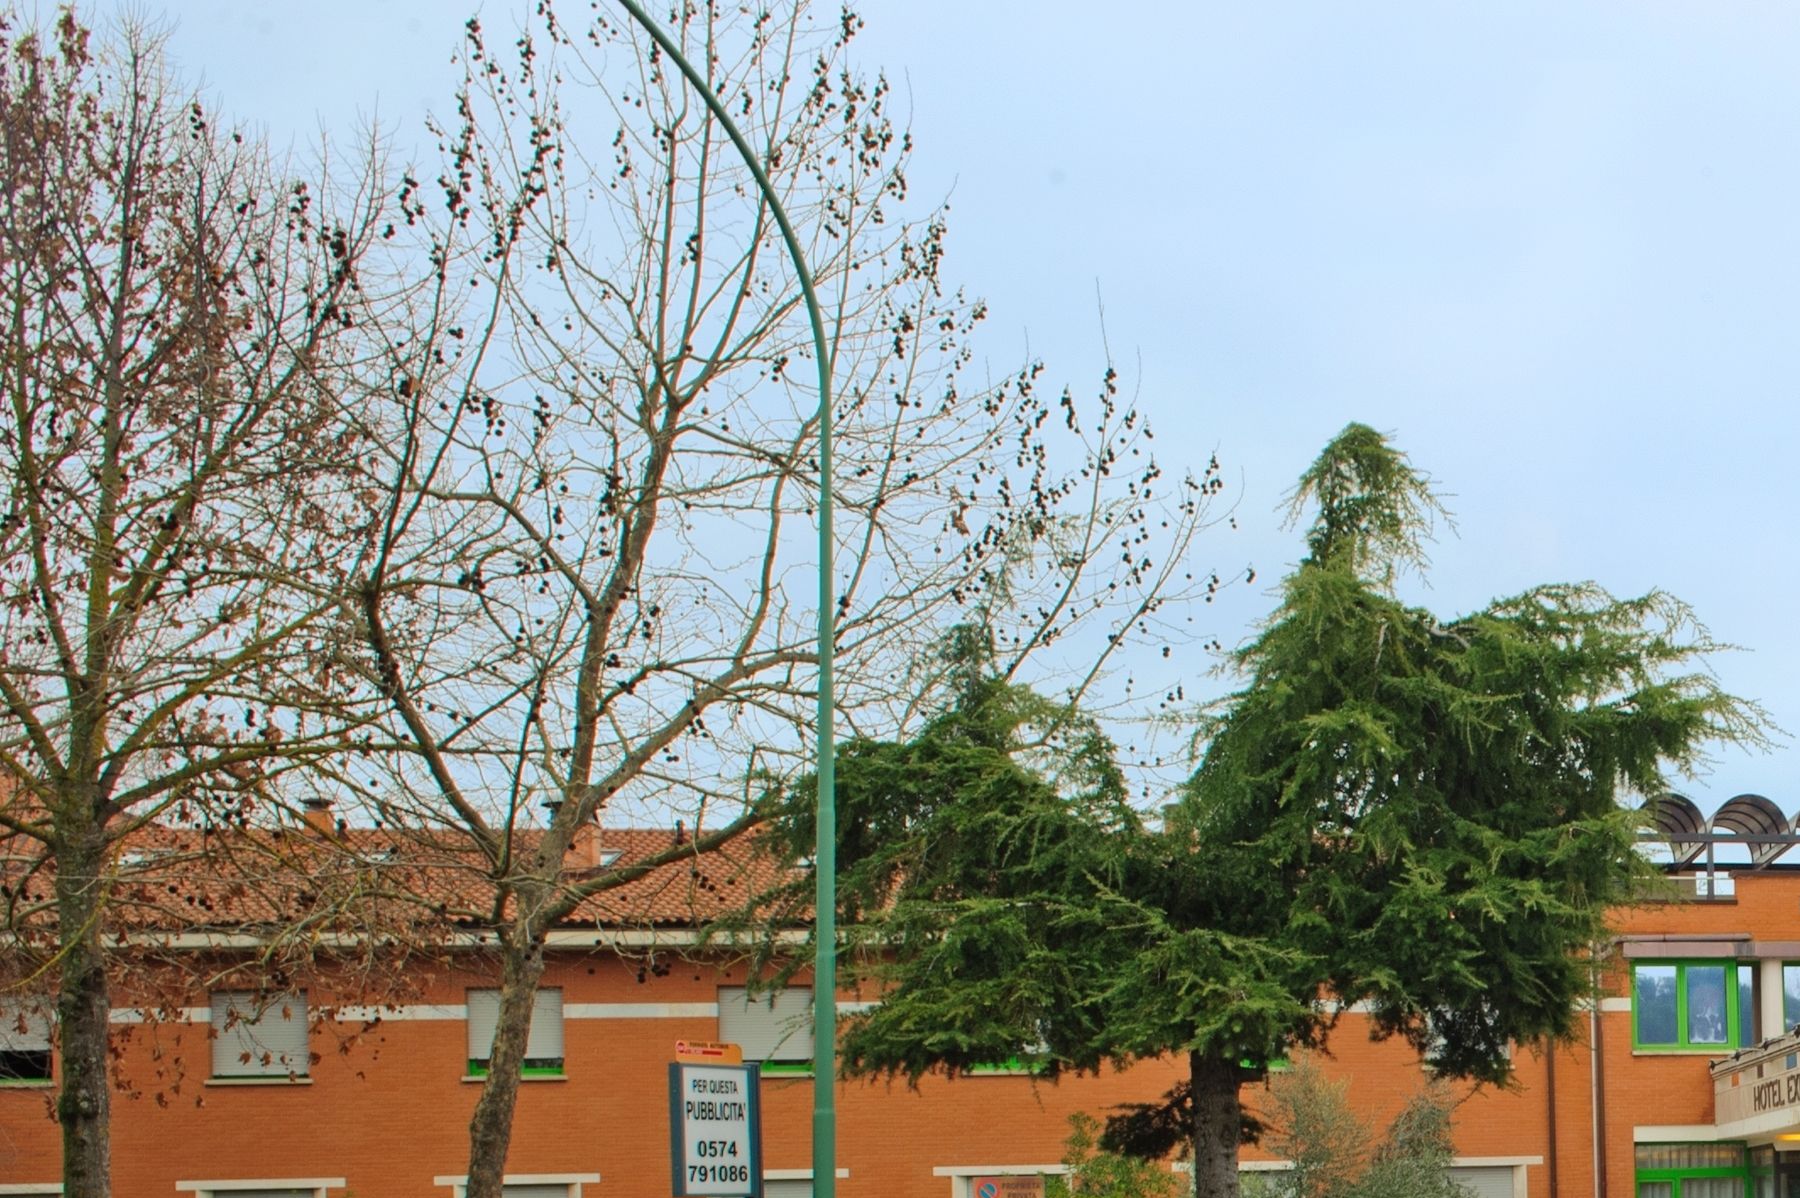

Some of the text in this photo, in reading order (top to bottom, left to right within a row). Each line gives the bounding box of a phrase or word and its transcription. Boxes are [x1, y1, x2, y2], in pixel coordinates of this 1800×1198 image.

[692, 1079, 738, 1094] PER QUESTA
[1753, 1079, 1785, 1112] HOTEL
[686, 1101, 746, 1121] PUBBLICITA'
[697, 1140, 738, 1157] 0574
[688, 1165, 748, 1182] 791086
